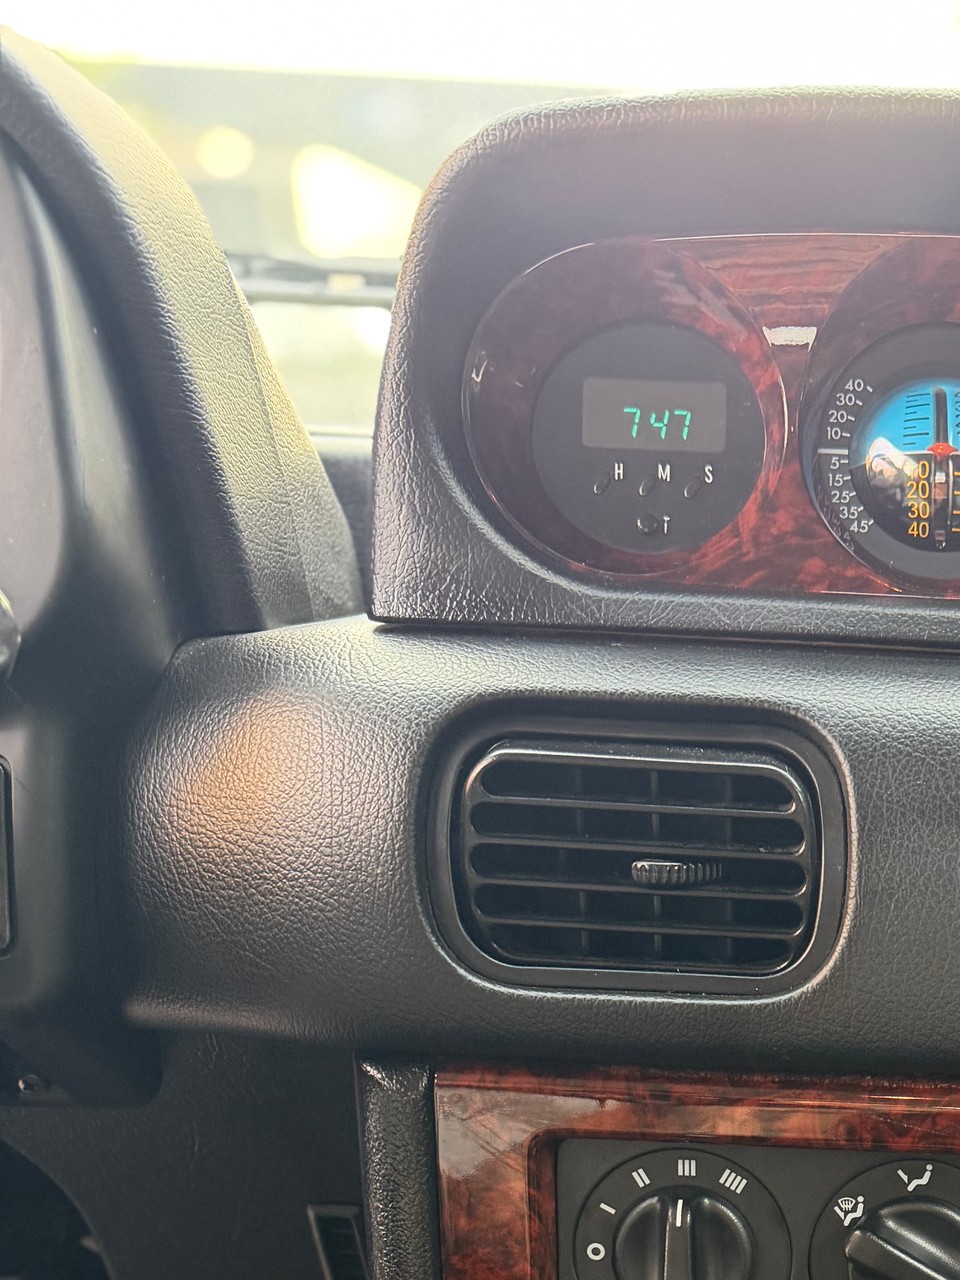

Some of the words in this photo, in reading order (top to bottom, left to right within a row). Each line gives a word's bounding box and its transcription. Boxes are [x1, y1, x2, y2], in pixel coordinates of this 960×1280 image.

[845, 379, 864, 392] 40
[836, 394, 855, 407] 30
[623, 406, 692, 440] 747
[829, 411, 847, 423] 20
[826, 427, 841, 440] 10
[830, 457, 840, 469] 5
[614, 463, 624, 480] H
[658, 464, 671, 482] M
[705, 464, 714, 484] S
[828, 474, 843, 487] 15
[907, 481, 930, 499] 20
[831, 491, 850, 503] 25
[839, 506, 858, 519] 35
[908, 501, 930, 519] 30
[662, 515, 671, 534] T
[850, 520, 868, 533] 45
[908, 522, 930, 538] 40
